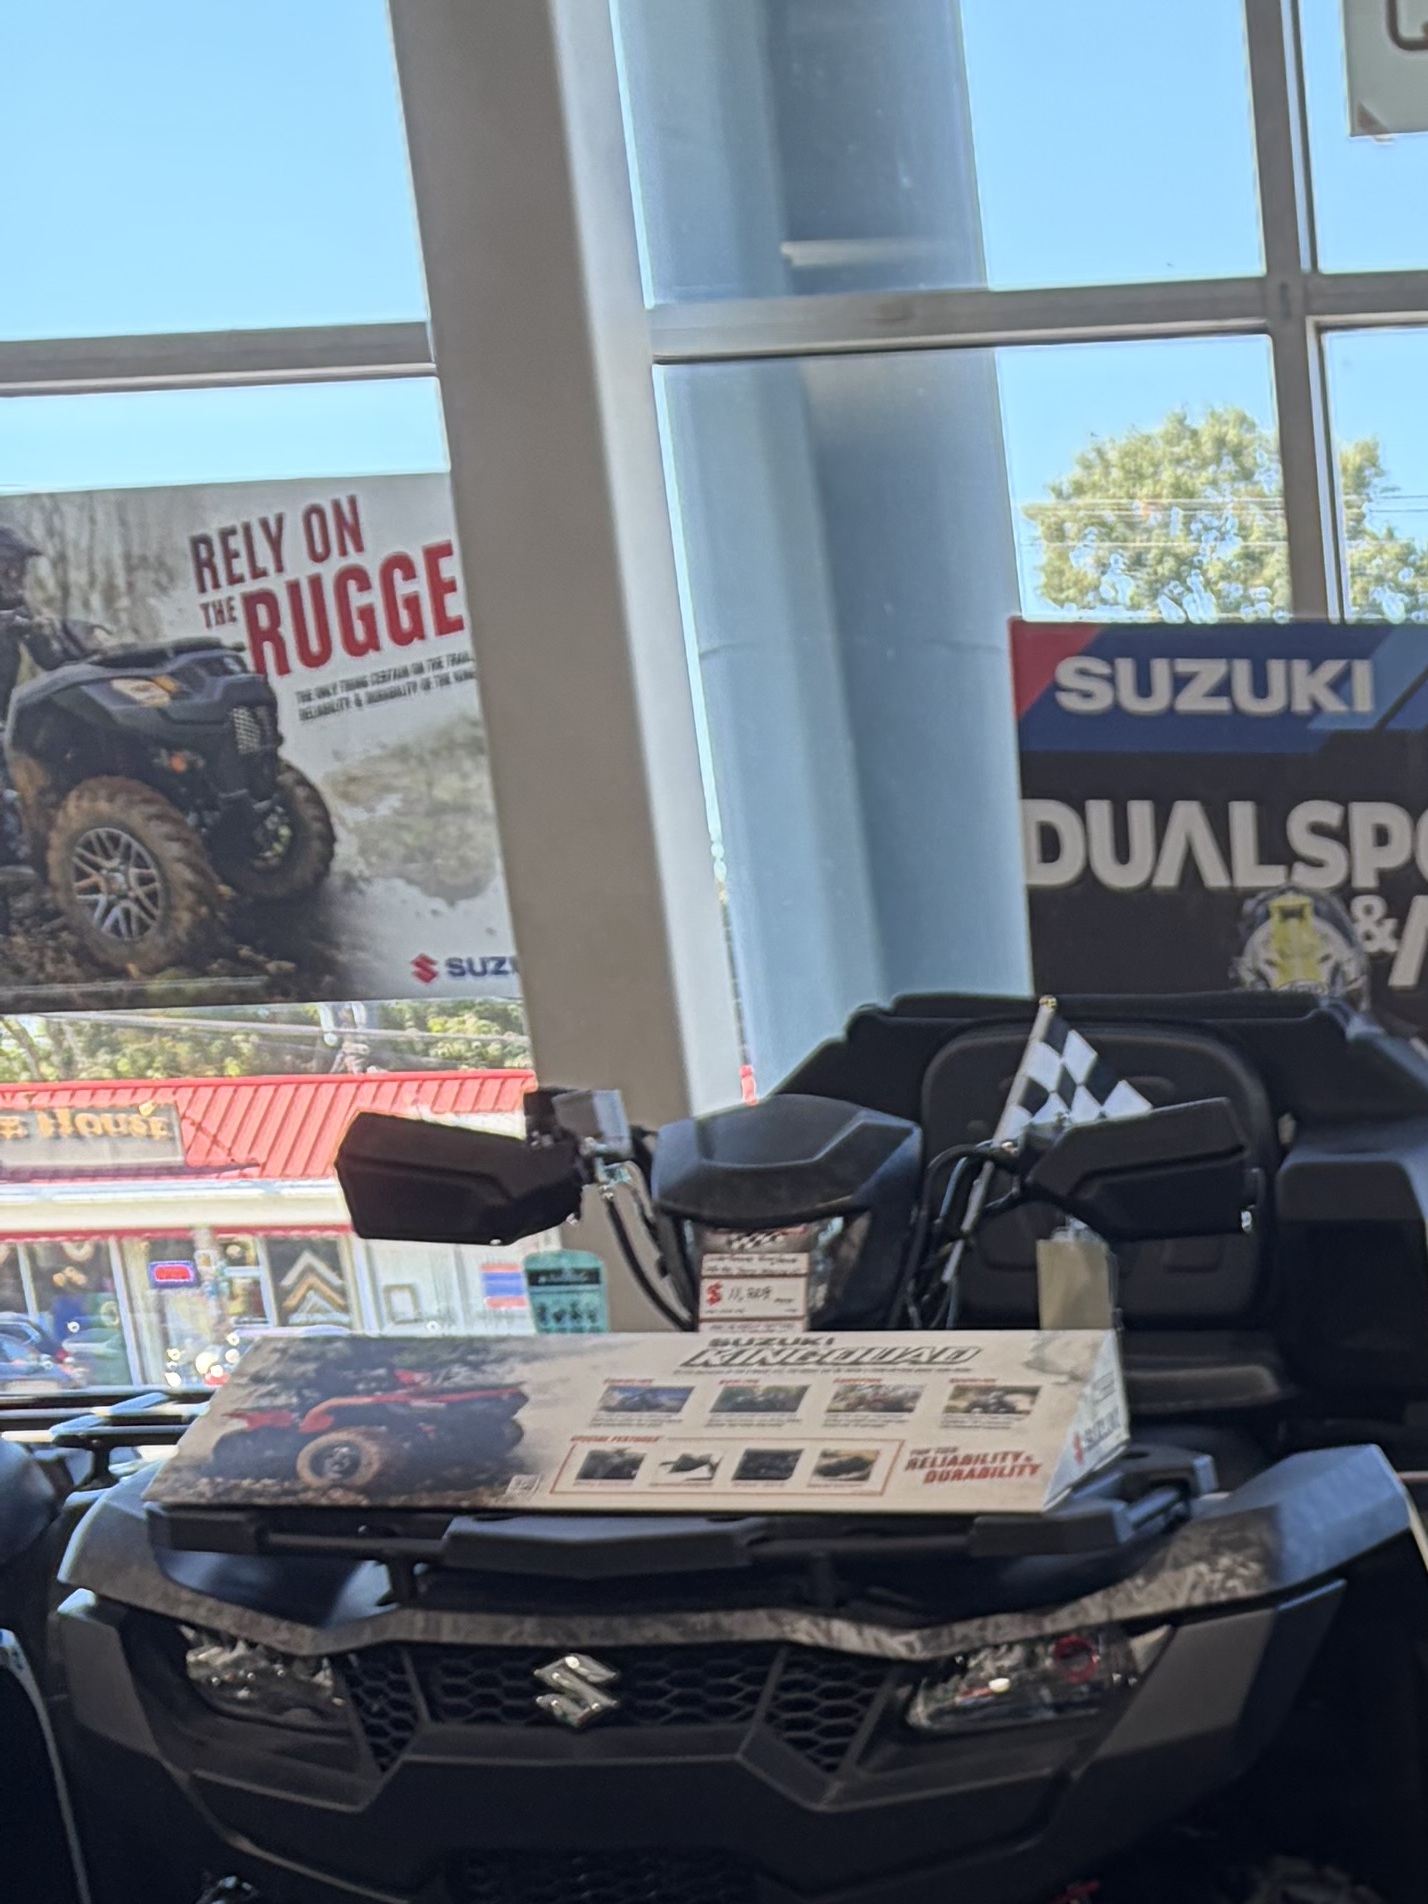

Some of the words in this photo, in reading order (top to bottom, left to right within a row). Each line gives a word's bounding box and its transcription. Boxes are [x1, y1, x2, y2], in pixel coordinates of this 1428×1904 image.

[188, 512, 286, 595] RELY
[302, 495, 365, 564] ON
[200, 596, 237, 629] THE
[1054, 656, 1375, 715] SUZUKI
[708, 1337, 836, 1347] SUZUKI
[904, 1450, 1024, 1472] RELIABILITY
[922, 1463, 1044, 1485] DURABILITY
